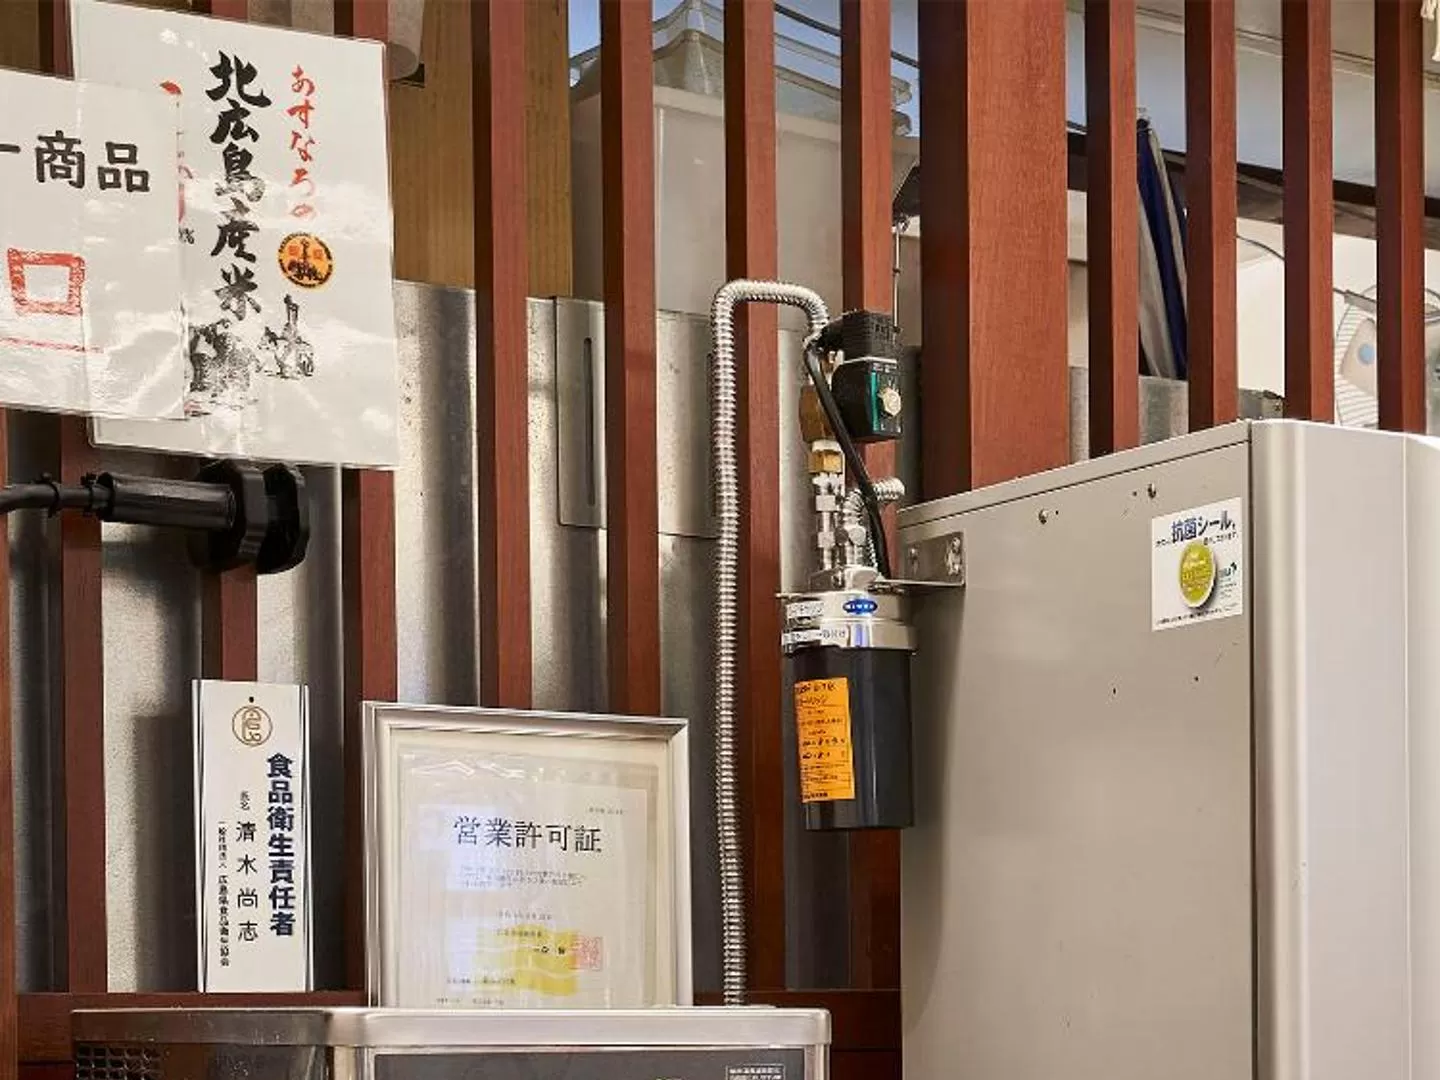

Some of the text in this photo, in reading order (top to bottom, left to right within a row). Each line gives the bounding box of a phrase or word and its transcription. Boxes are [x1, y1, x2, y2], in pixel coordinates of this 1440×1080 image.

[266, 751, 296, 937] 食品衛生責任者
[453, 815, 602, 853] 営業許可証
